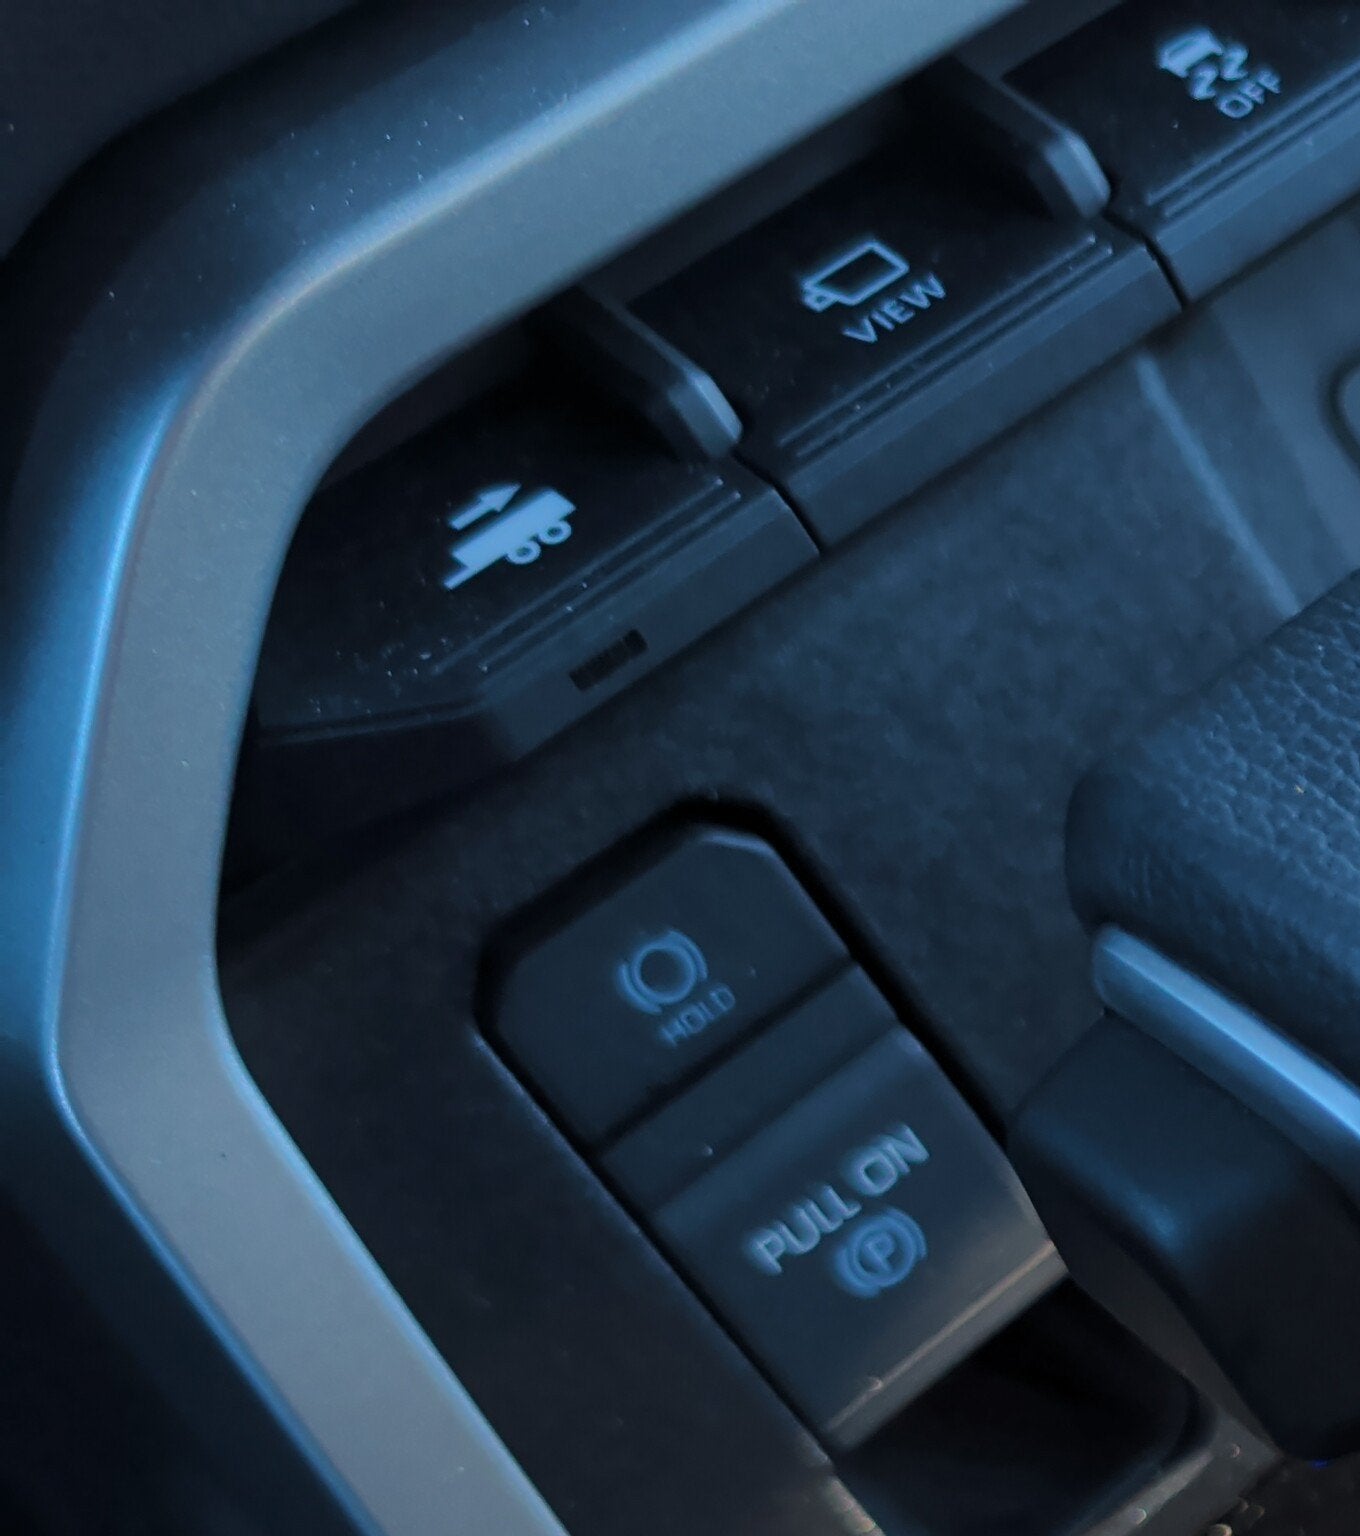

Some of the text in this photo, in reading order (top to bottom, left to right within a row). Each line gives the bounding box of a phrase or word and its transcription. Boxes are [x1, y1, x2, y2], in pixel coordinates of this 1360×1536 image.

[1217, 69, 1281, 119] OFF
[842, 274, 947, 344] VIEW
[660, 985, 737, 1047] HOLD
[743, 1124, 931, 1276] PULL ON
